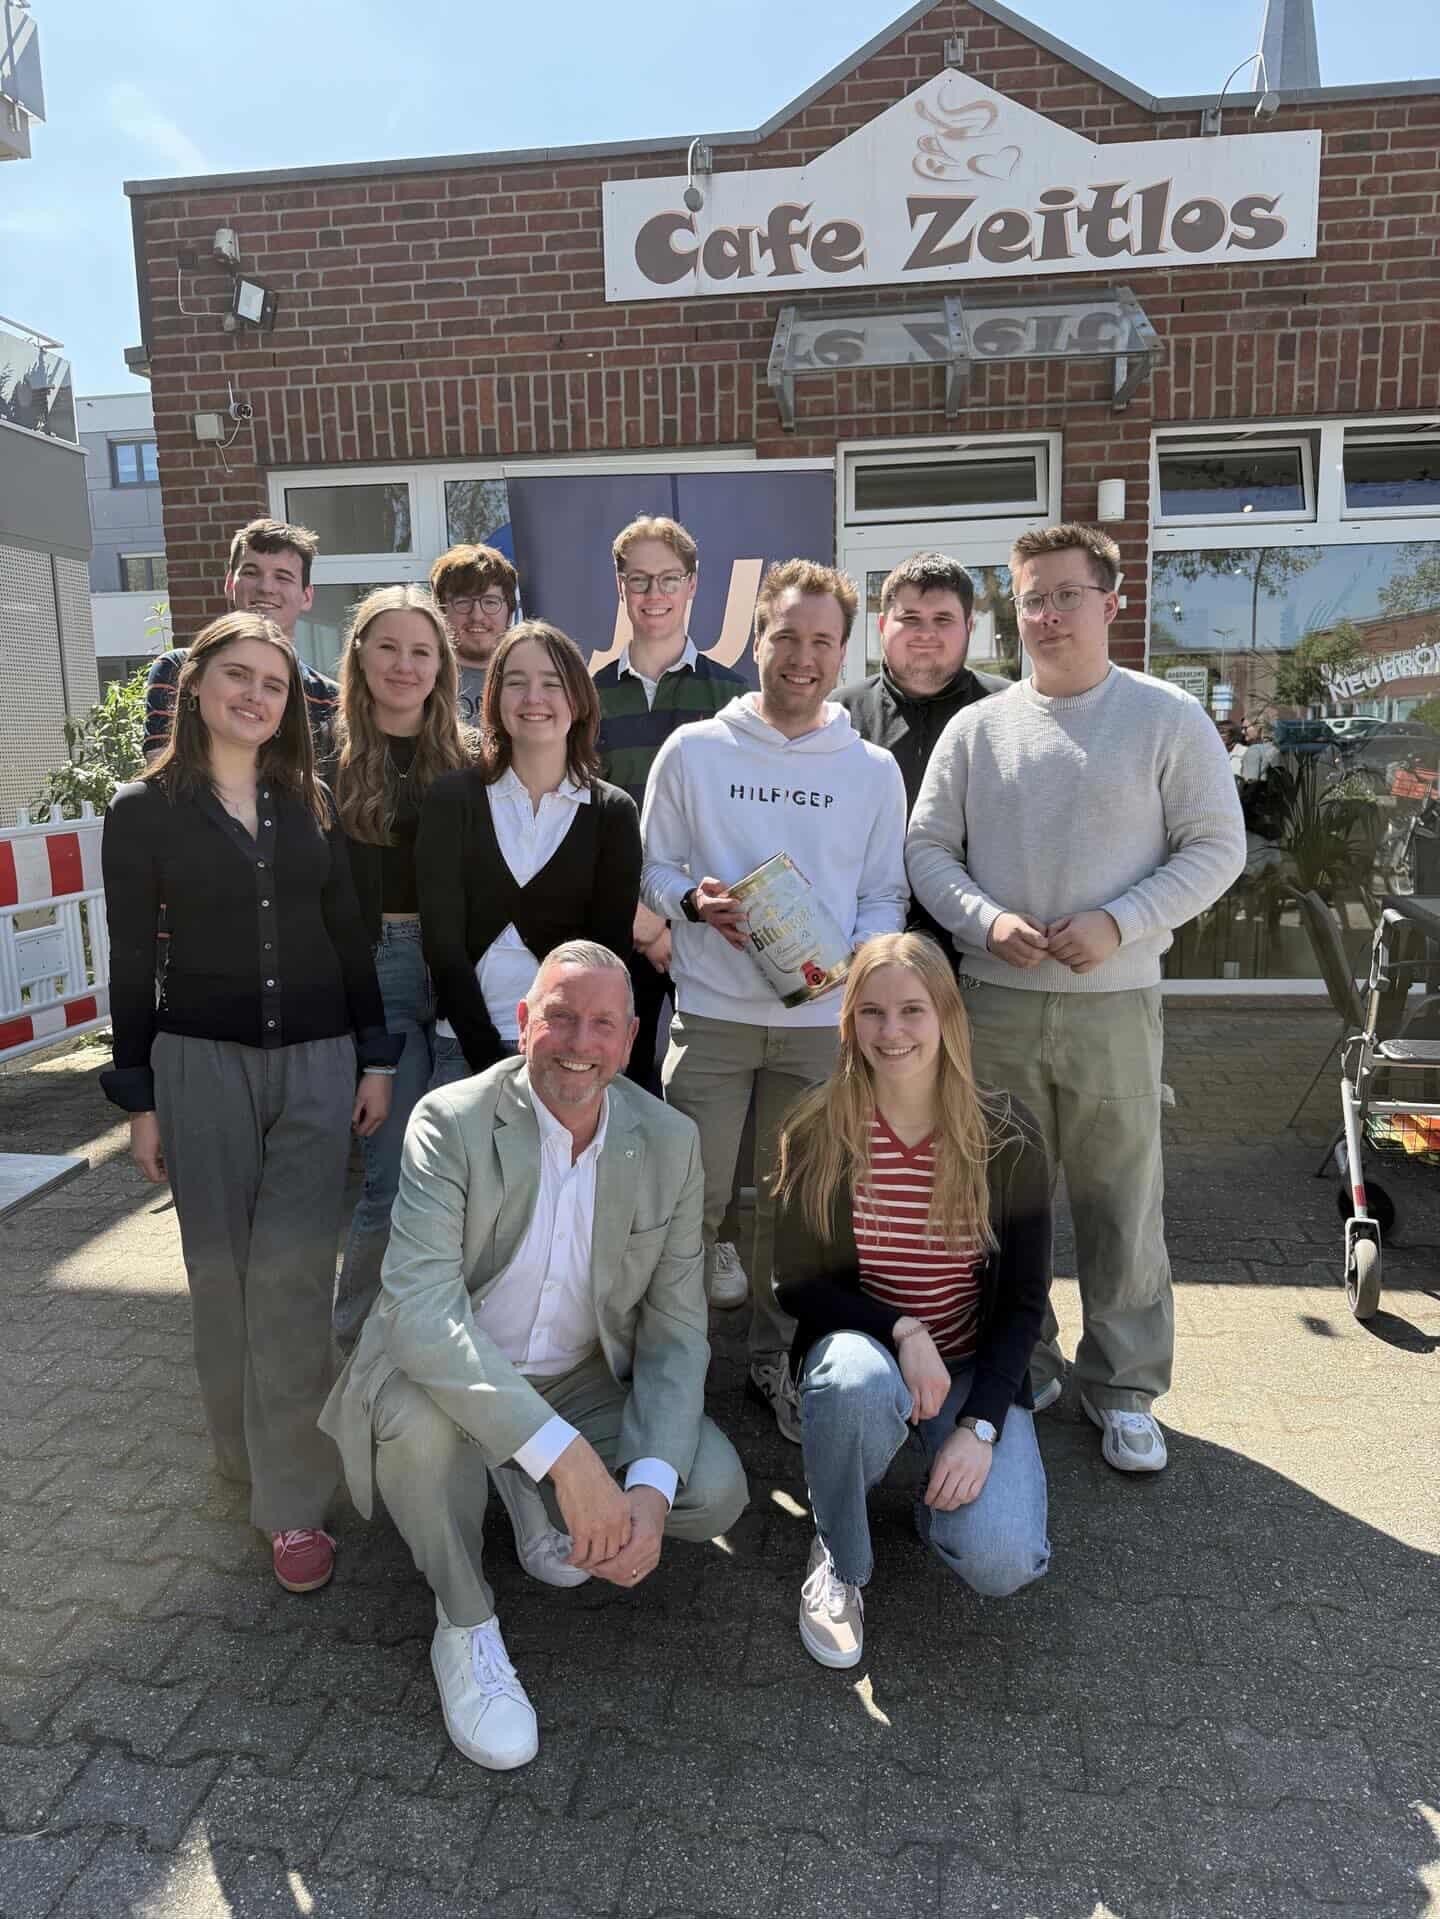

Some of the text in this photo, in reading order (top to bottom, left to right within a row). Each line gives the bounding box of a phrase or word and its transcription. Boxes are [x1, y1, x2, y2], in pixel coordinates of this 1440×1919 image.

[634, 177, 1288, 285] Cafe Zeitlos
[730, 783, 835, 809] HILFIGER
